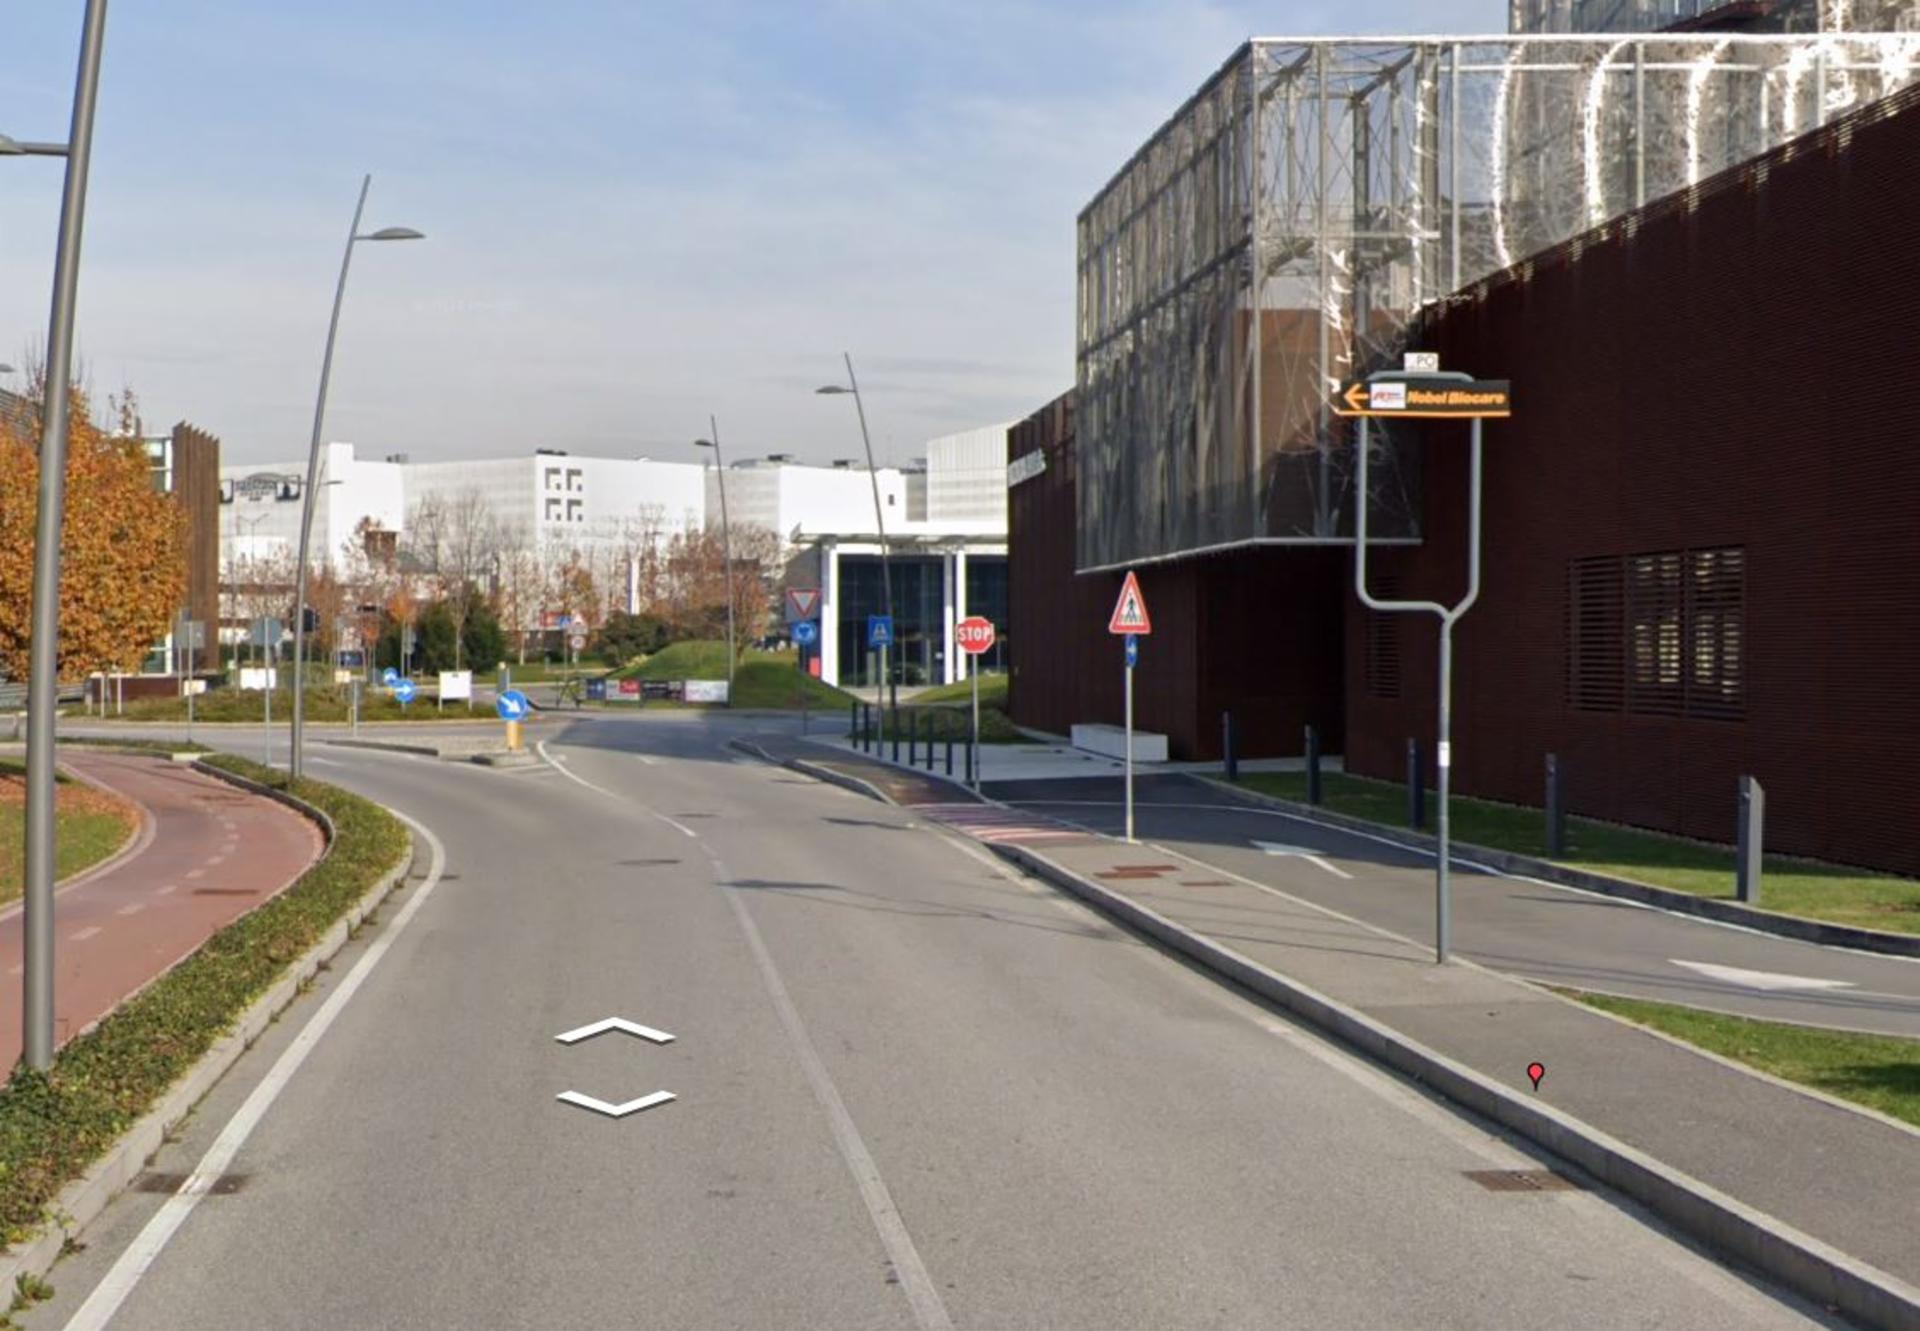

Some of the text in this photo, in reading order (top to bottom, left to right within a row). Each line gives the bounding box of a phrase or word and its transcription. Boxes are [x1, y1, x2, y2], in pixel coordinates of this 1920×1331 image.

[1407, 390, 1447, 405] Nobel
[1447, 391, 1505, 404] Biocare
[958, 626, 992, 642] STOP
